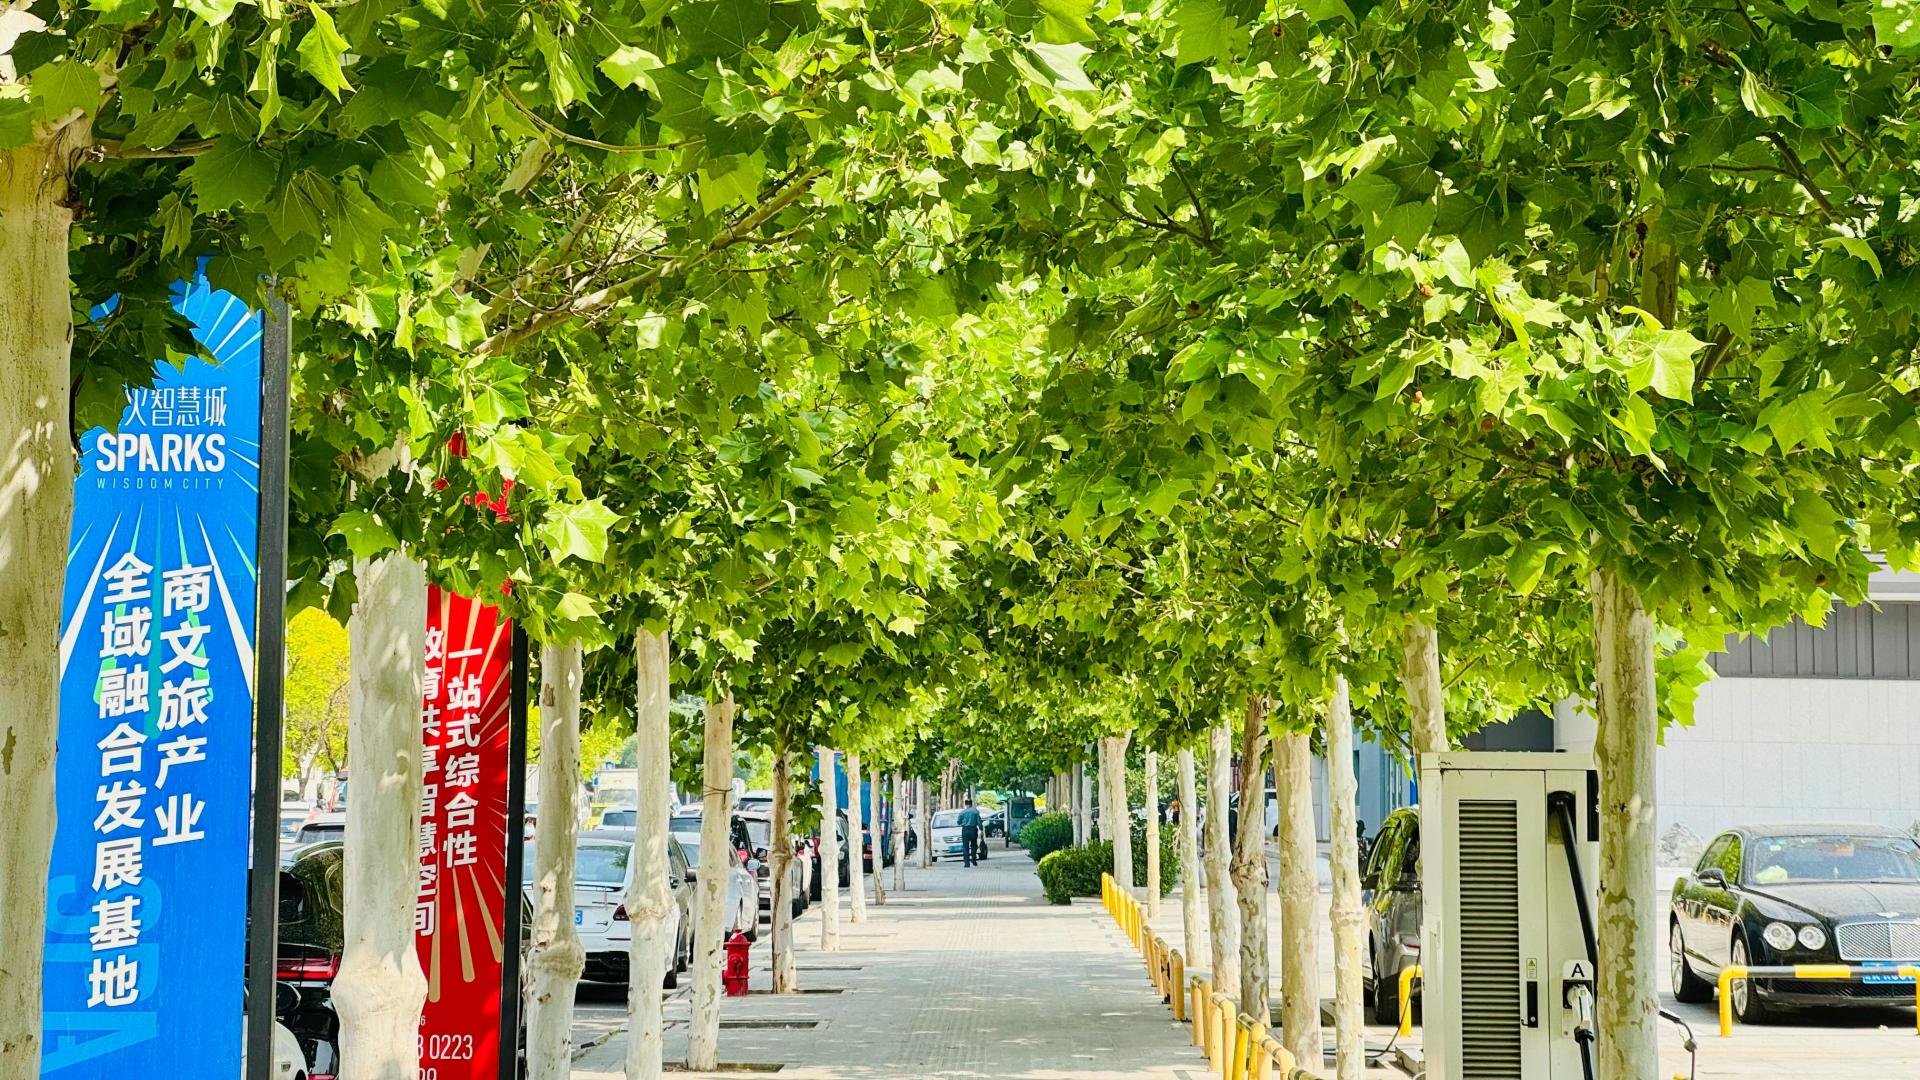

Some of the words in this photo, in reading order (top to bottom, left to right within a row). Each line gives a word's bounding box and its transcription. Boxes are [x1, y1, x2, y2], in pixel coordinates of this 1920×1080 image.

[96, 433, 226, 472] SPARKS
[97, 478, 172, 489] WISDOM
[182, 478, 224, 489] CITY
[152, 564, 213, 847] 商文旅产业
[443, 648, 483, 868] 一站式综合性
[86, 552, 154, 1008] 全域融合发展基地
[1571, 963, 1585, 978] A
[429, 1034, 473, 1060] 0223
